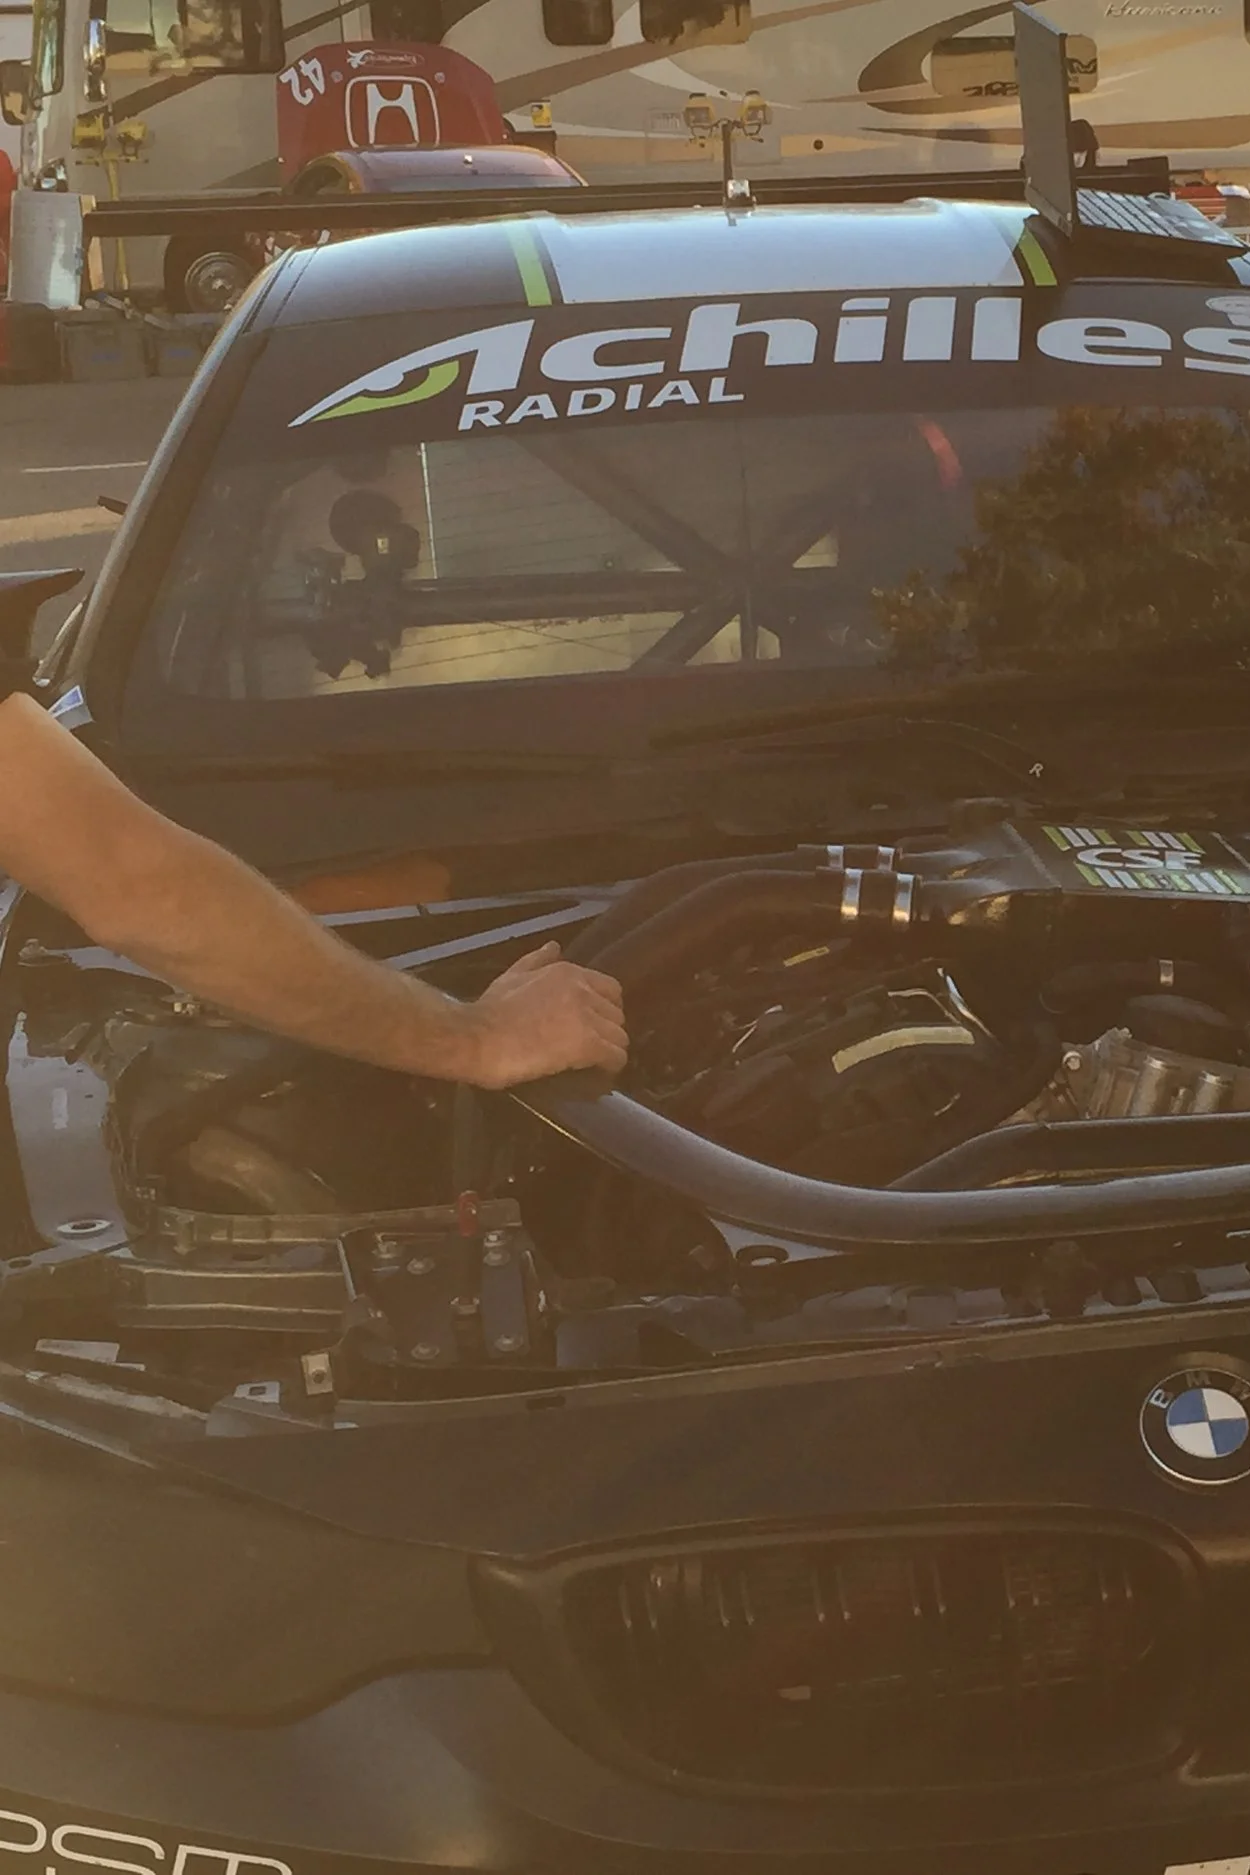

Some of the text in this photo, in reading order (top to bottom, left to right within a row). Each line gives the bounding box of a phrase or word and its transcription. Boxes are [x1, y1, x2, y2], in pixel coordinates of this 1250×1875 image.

[279, 57, 325, 106] 42
[457, 376, 746, 432] RADIAL
[1077, 848, 1202, 870] CSF
